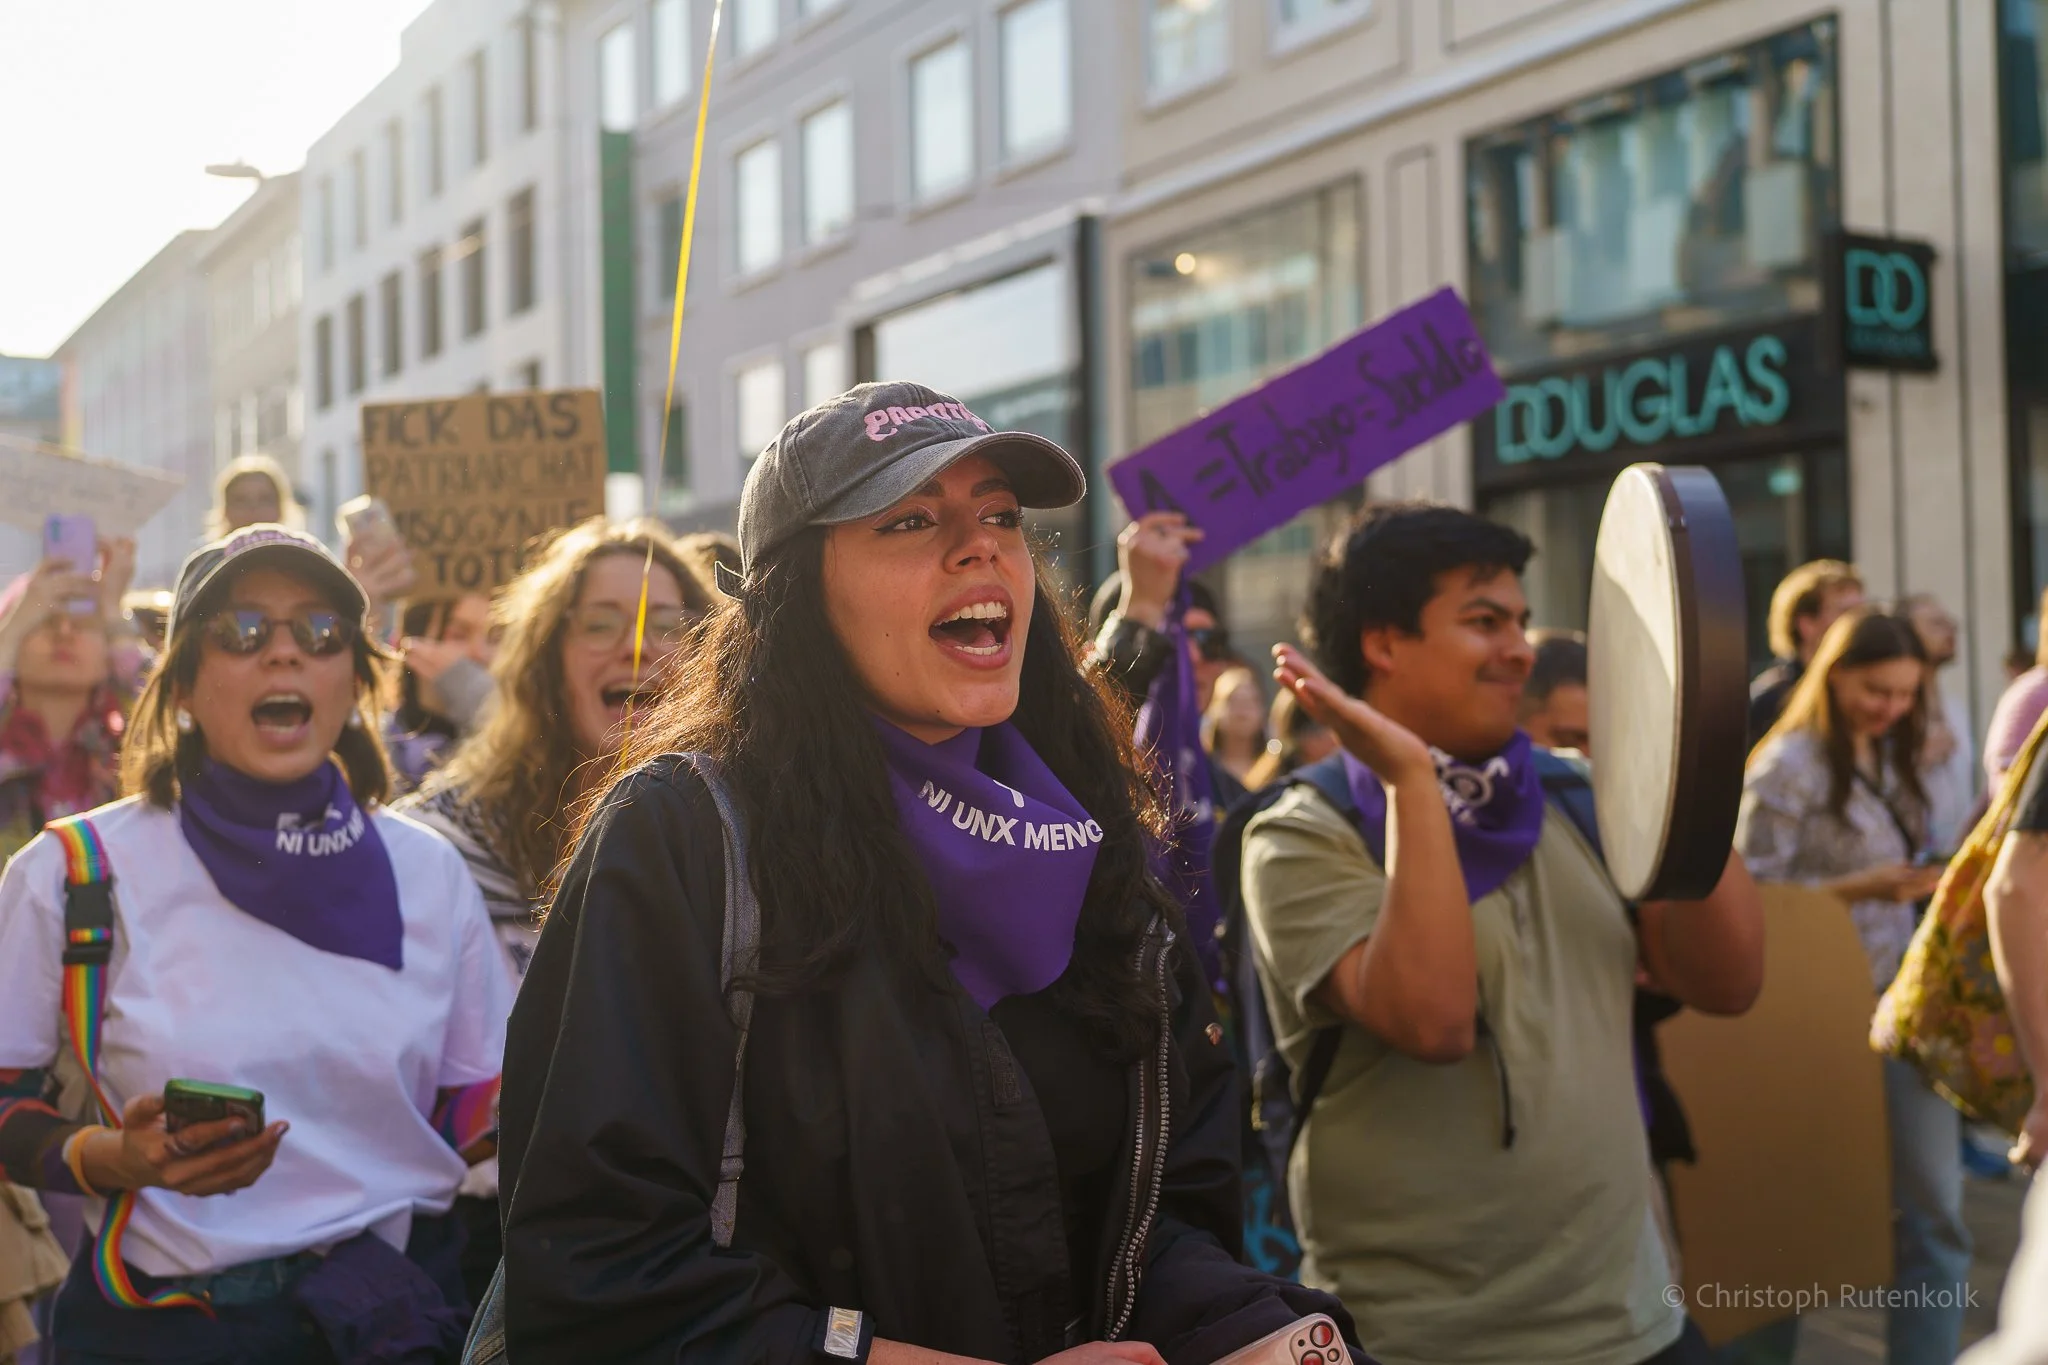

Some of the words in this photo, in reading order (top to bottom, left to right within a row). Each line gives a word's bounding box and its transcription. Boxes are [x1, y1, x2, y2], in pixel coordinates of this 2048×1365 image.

[364, 402, 459, 449] FICK
[487, 393, 582, 441] DAS
[1496, 334, 1790, 464] DOUGLAS
[276, 829, 303, 856] NI
[308, 826, 354, 857] UNX
[917, 779, 952, 813] NI
[952, 801, 1019, 846] UNX
